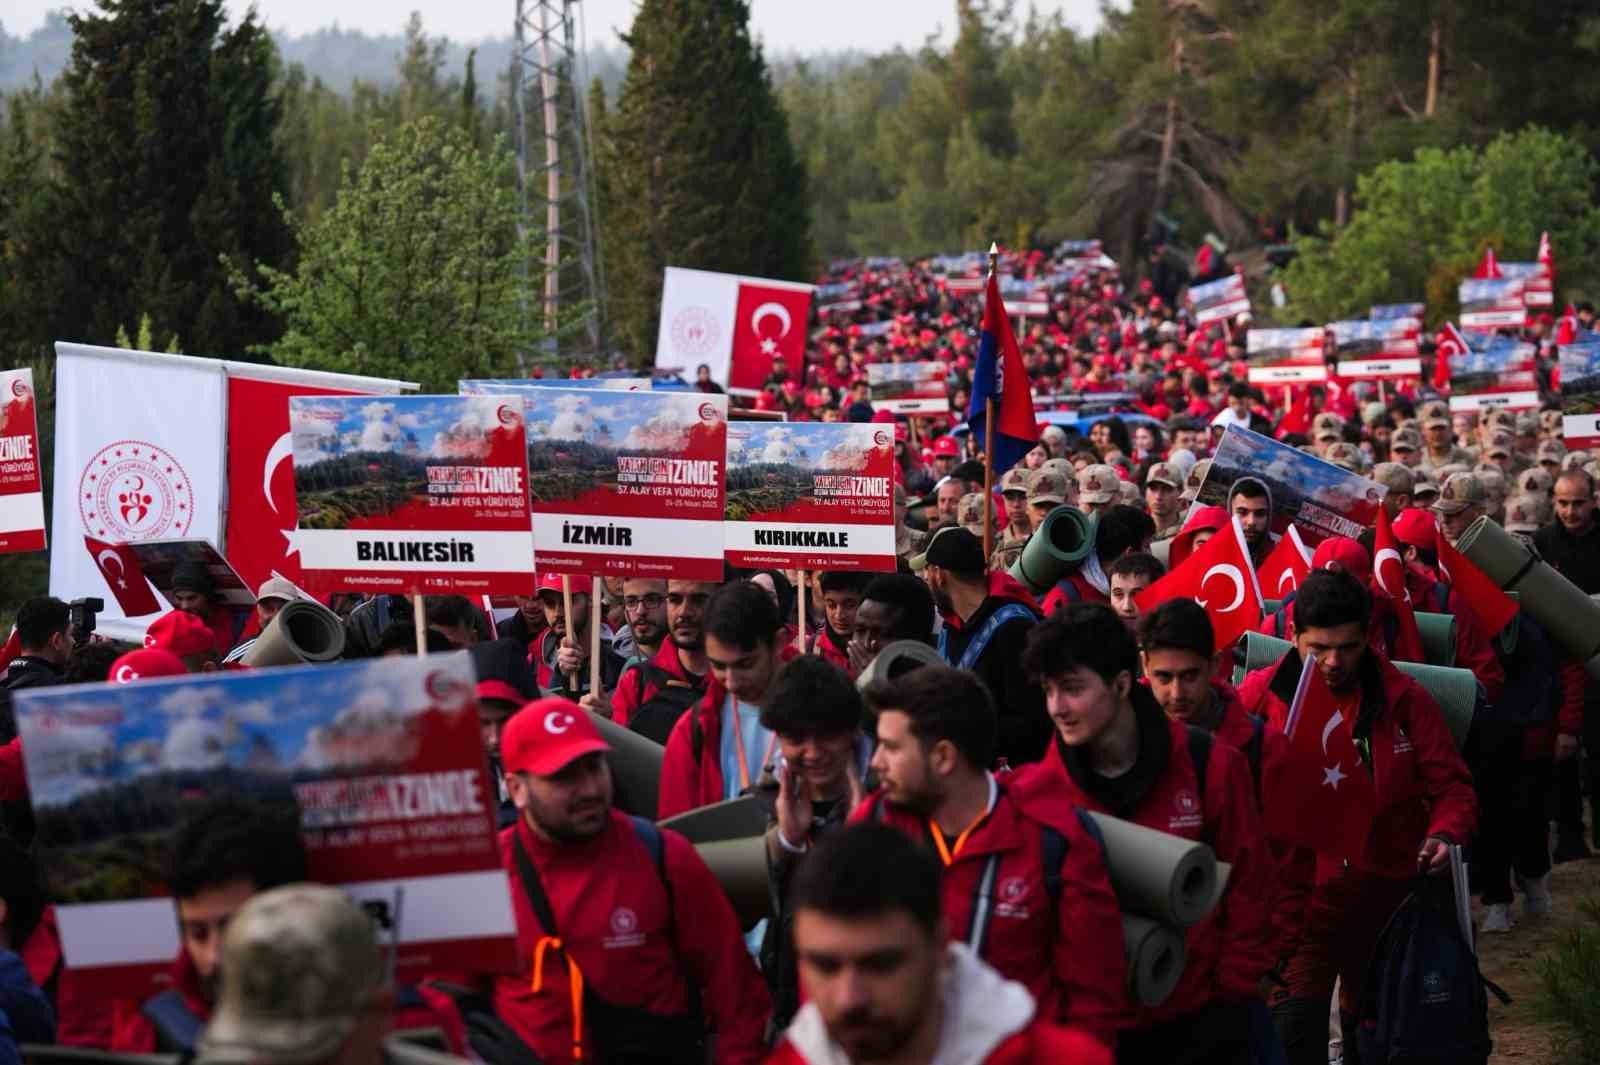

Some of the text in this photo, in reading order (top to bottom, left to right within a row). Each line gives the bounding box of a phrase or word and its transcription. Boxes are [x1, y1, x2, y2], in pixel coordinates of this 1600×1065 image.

[0, 435, 33, 461] ZİNDE
[474, 466, 523, 493] İZİNDE
[667, 459, 719, 486] İZİNDE
[629, 486, 651, 496] ALAY
[652, 487, 673, 497] VEFA
[674, 486, 719, 500] YÜRÜYÜŞÜ
[851, 476, 890, 497] İZİNDE
[441, 497, 460, 507] ALAY
[462, 497, 482, 507] VEFA
[483, 496, 525, 509] YÜRÜYÜŞÜ
[563, 520, 632, 546] İZMİR
[754, 529, 848, 547] KIRIKKALE
[357, 537, 475, 562] BALIKESİR
